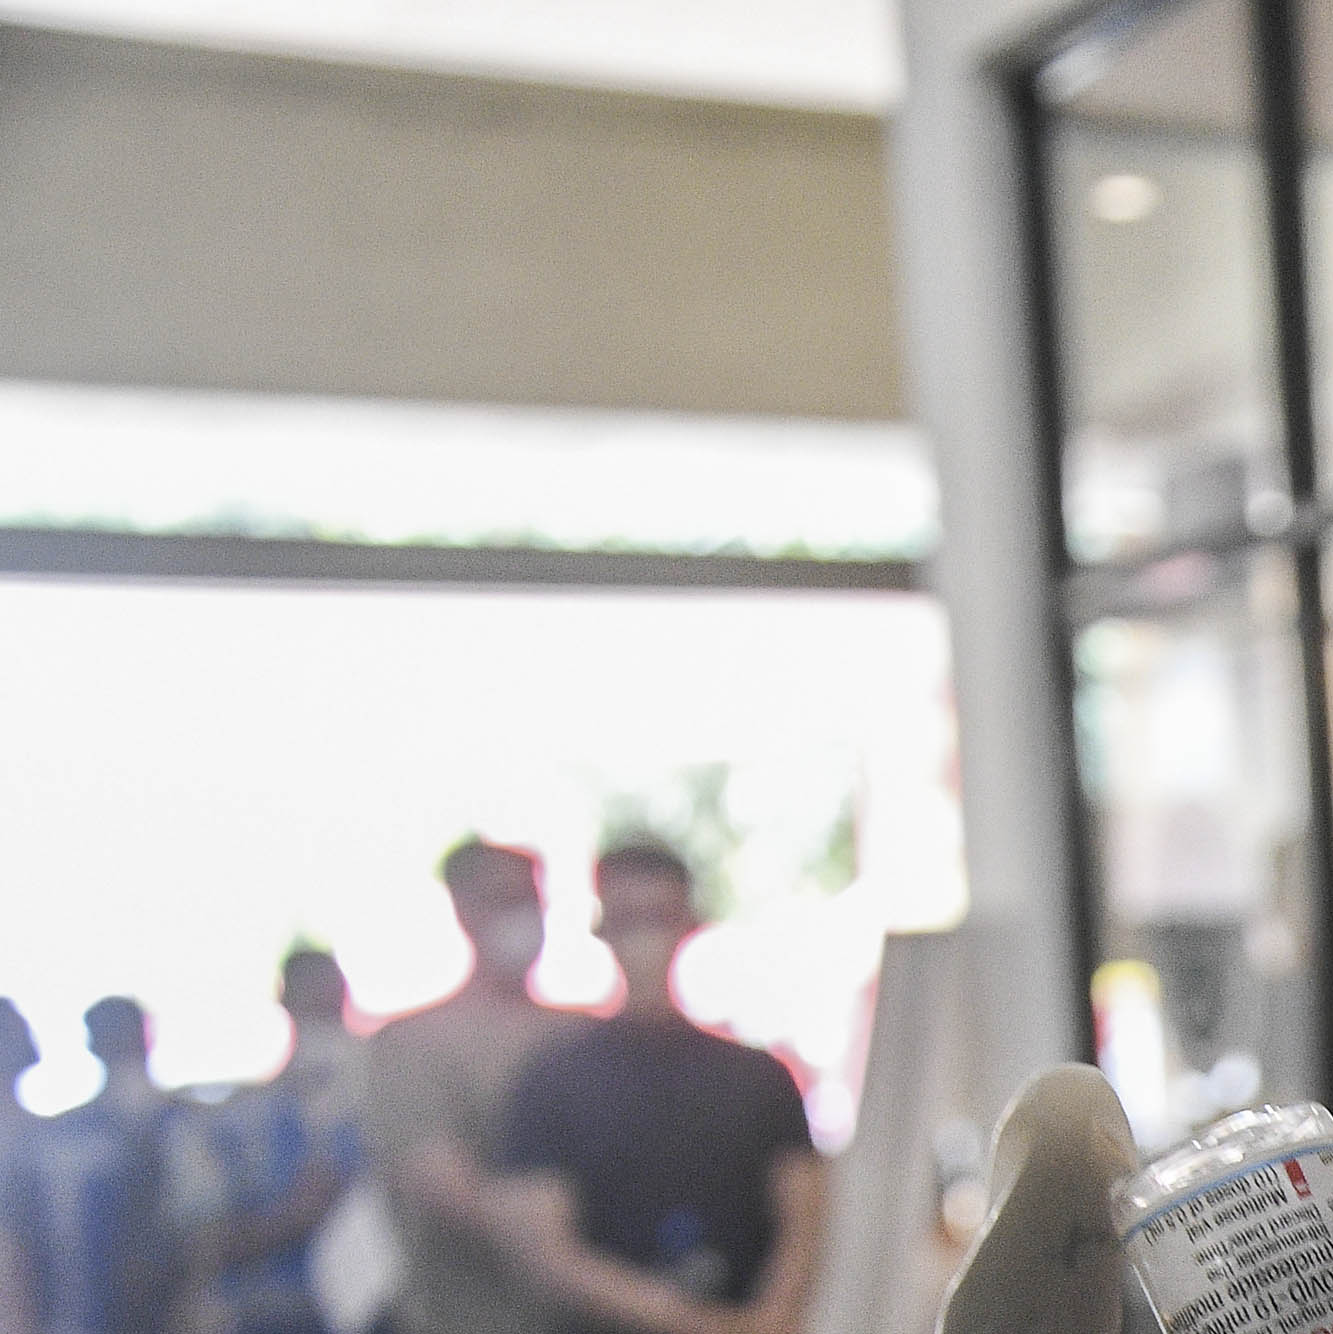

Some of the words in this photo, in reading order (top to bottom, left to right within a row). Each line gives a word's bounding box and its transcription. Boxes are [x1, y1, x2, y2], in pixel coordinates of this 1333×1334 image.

[1186, 1196, 1205, 1219] of
[1203, 1176, 1253, 1208] doses
[1211, 1186, 1288, 1230] Multidose
[1185, 1217, 1213, 1245] vial
[1267, 1202, 1321, 1237] Discard
[1234, 1222, 1330, 1269] Intramuscular
[1205, 1261, 1235, 1284] Use
